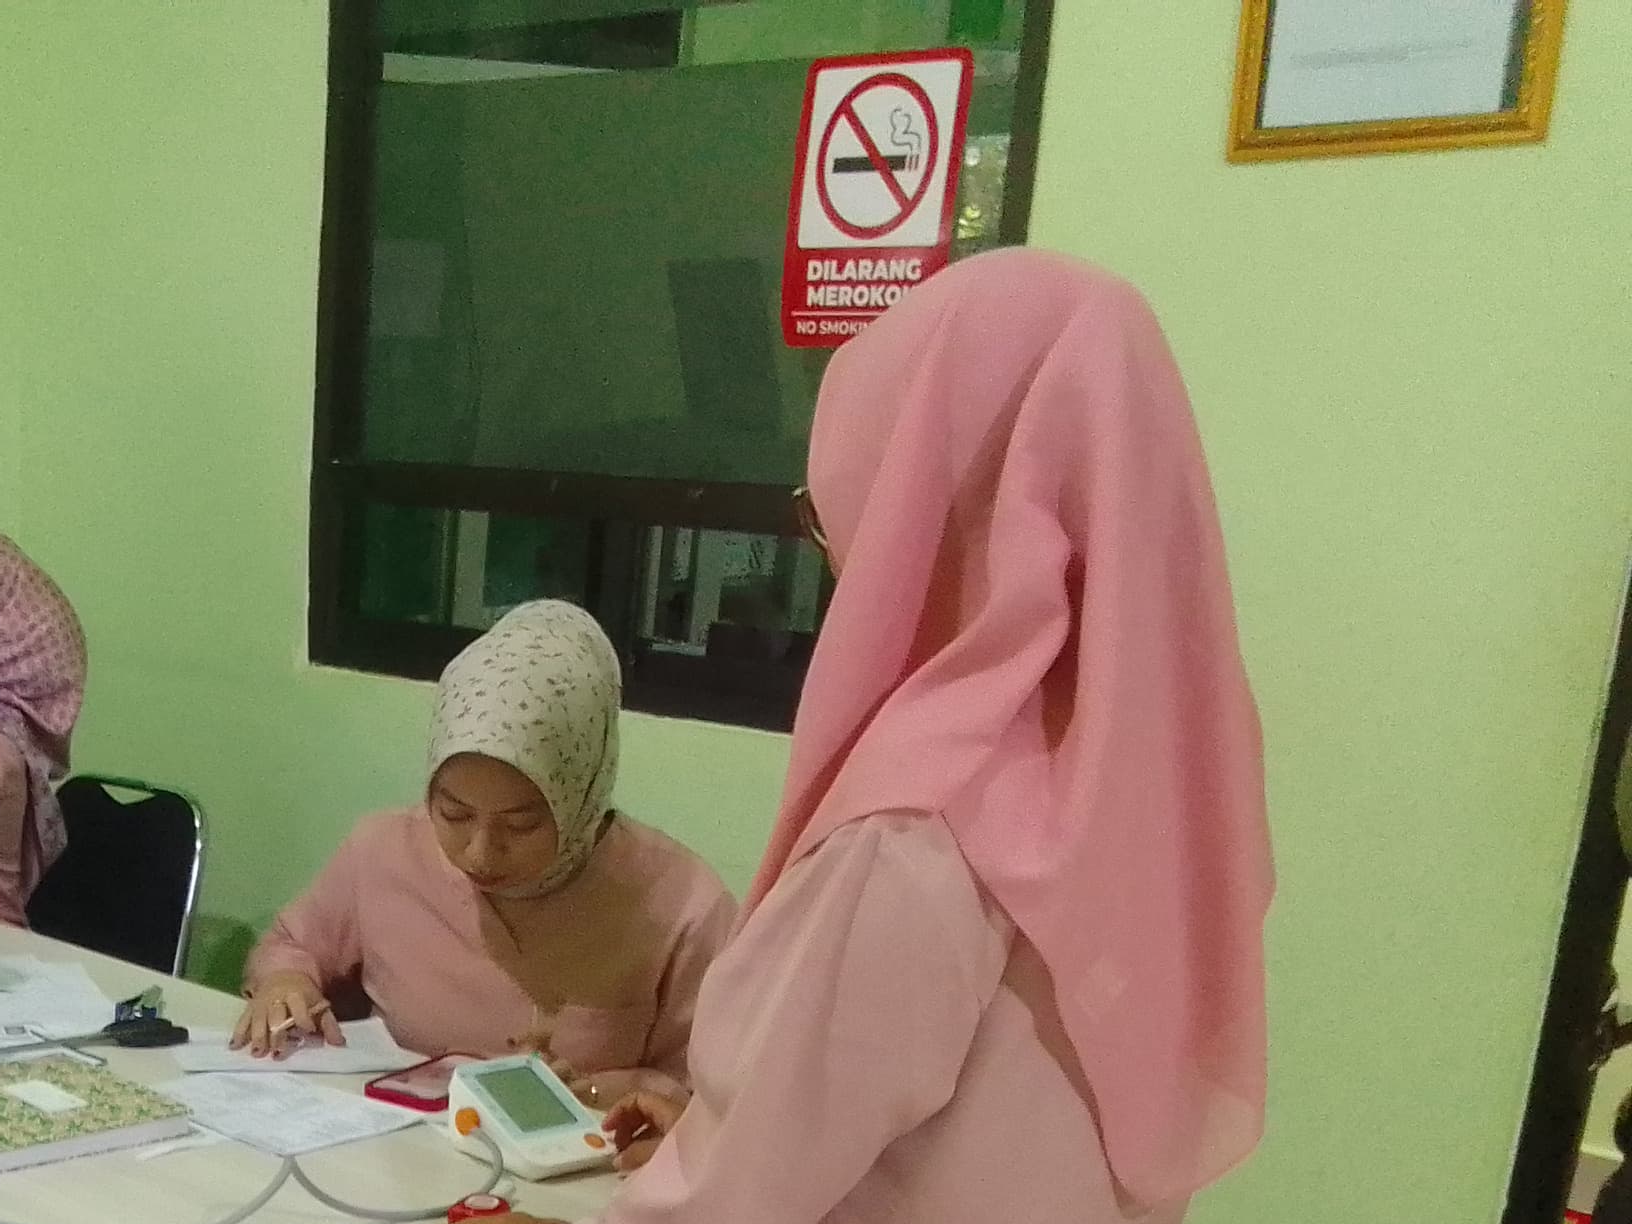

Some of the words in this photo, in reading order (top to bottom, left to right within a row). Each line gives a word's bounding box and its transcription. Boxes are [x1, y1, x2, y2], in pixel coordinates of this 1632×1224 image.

[807, 259, 922, 282] DILARANG
[796, 321, 817, 335] NO
[819, 321, 868, 335] SMOKI
